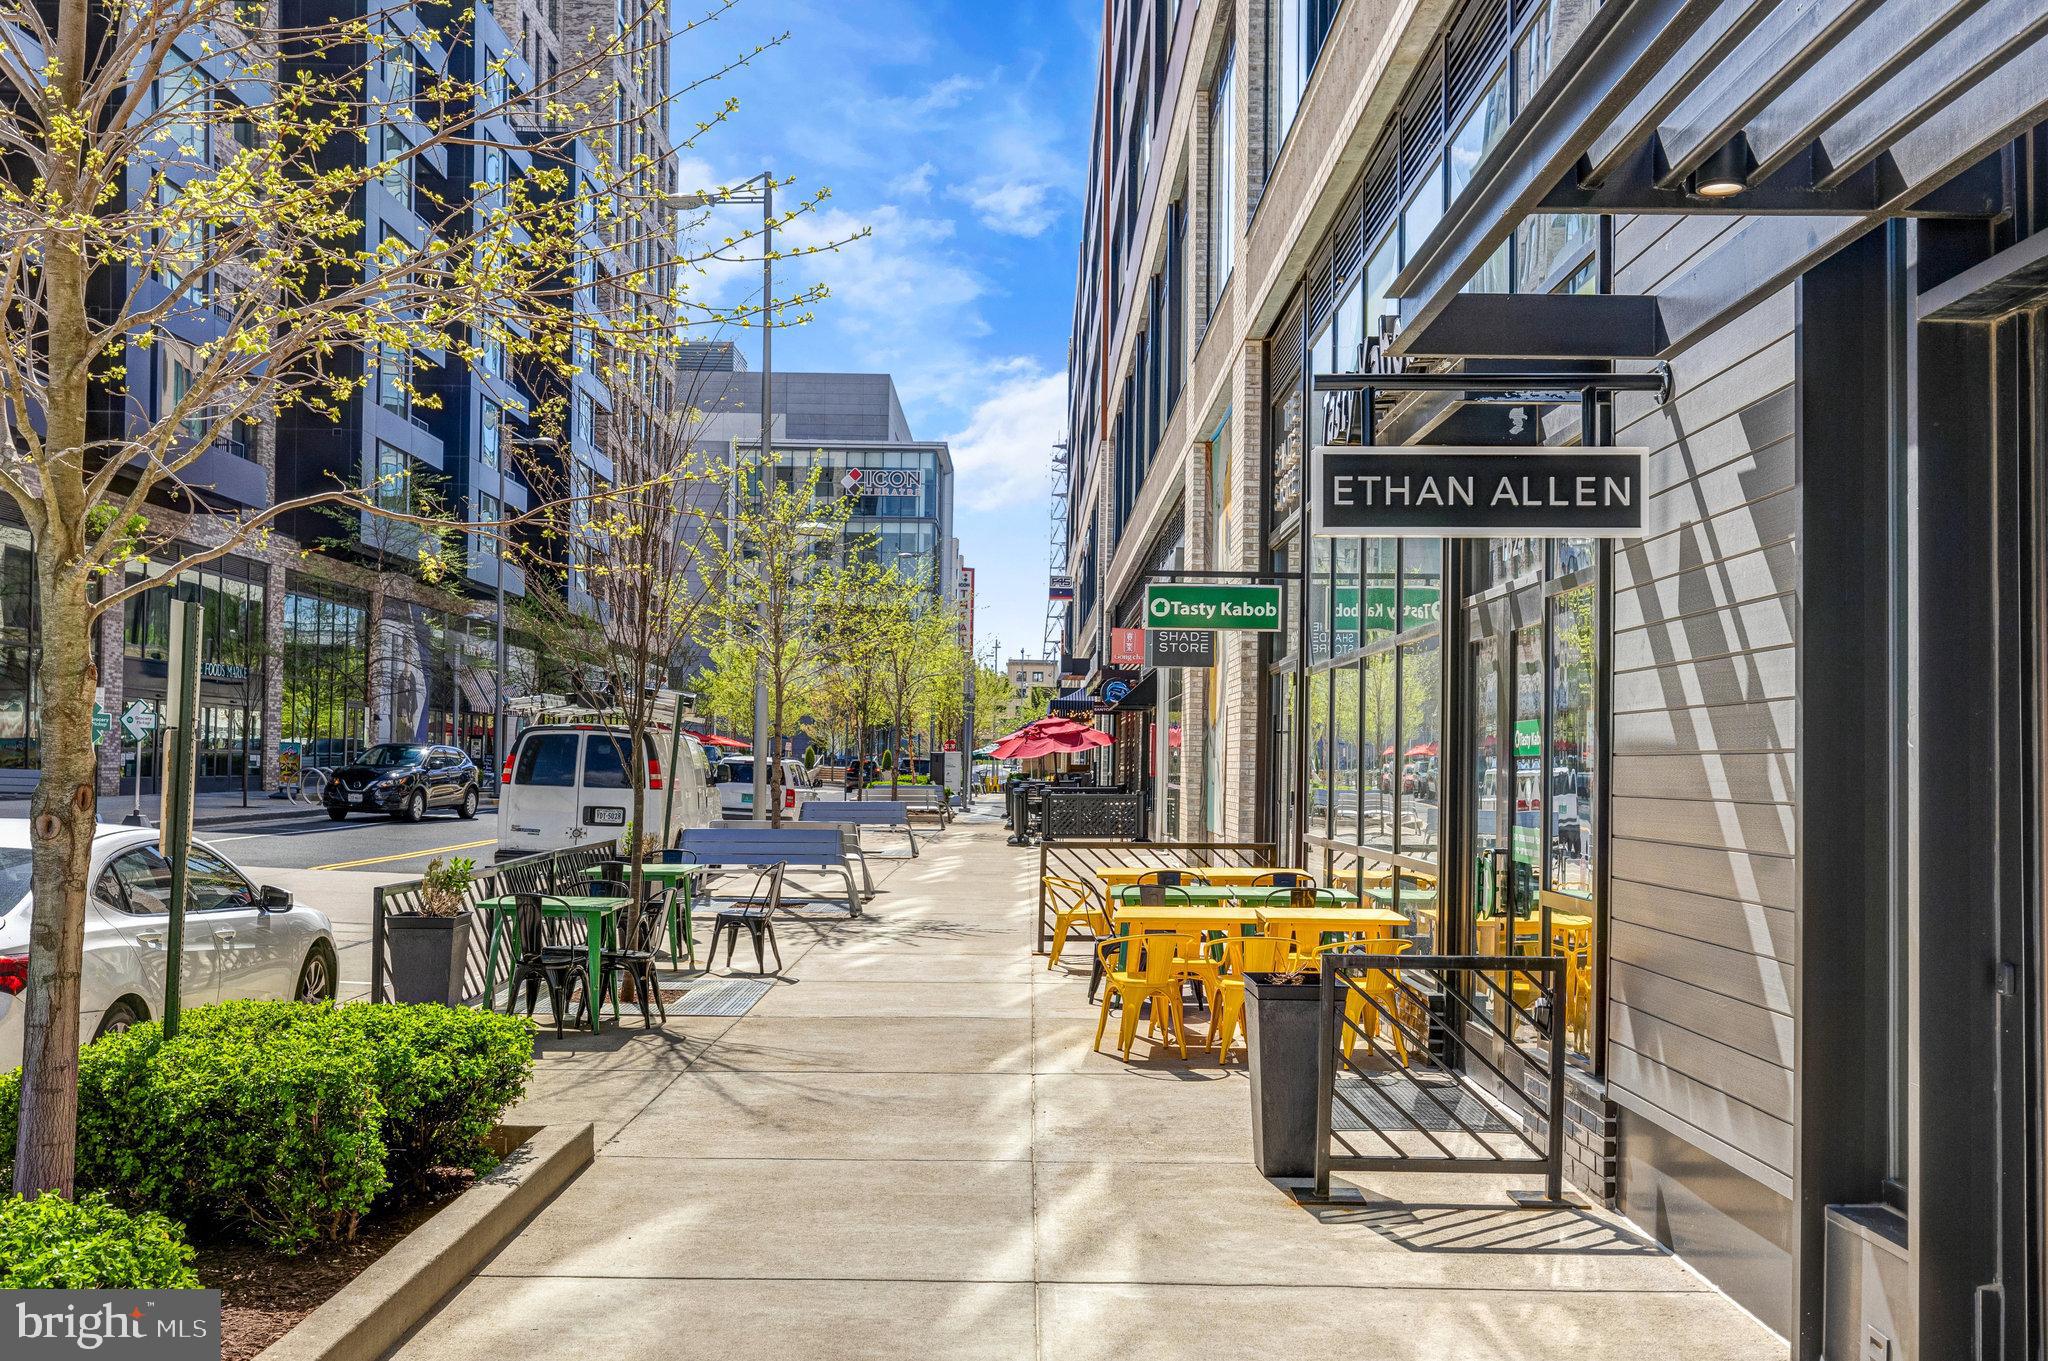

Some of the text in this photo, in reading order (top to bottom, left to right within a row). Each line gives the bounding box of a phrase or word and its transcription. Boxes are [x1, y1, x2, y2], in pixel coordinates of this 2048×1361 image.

[866, 470, 921, 487] ICON
[866, 488, 921, 496] THEATRE
[1333, 476, 1474, 506] ETHAN
[1491, 476, 1631, 506] ALLEN
[1051, 577, 1071, 587] F45
[1170, 601, 1277, 619] Tasty Kabob
[1159, 632, 1209, 642] SHADE
[1159, 643, 1209, 653] STORE
[204, 663, 225, 677] FOODS
[226, 664, 247, 680] MARKE
[1531, 731, 1541, 746] Kab
